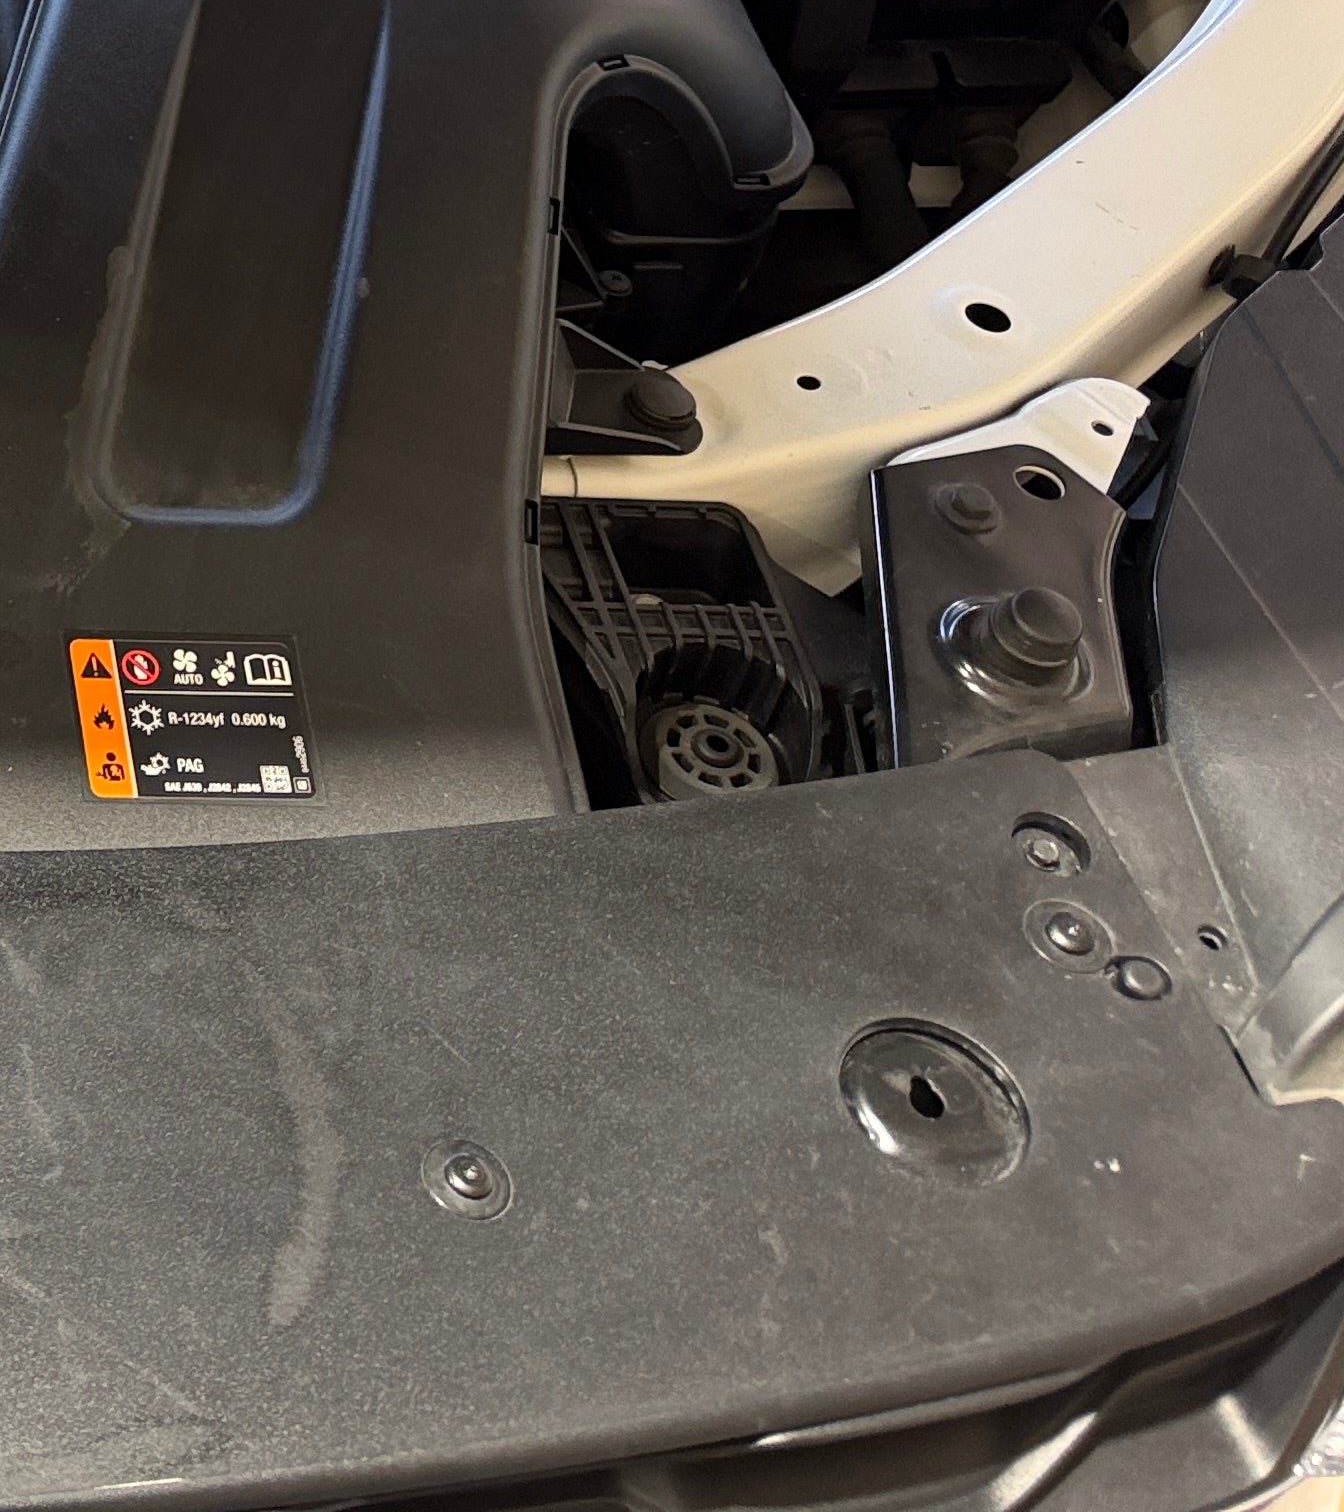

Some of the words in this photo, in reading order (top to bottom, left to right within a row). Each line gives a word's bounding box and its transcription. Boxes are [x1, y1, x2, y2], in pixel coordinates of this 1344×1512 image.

[173, 673, 204, 686] AUTO
[167, 711, 225, 729] R-1234yf
[231, 712, 267, 726] 0.600
[269, 713, 287, 729] kg
[176, 757, 205, 773] PAG
